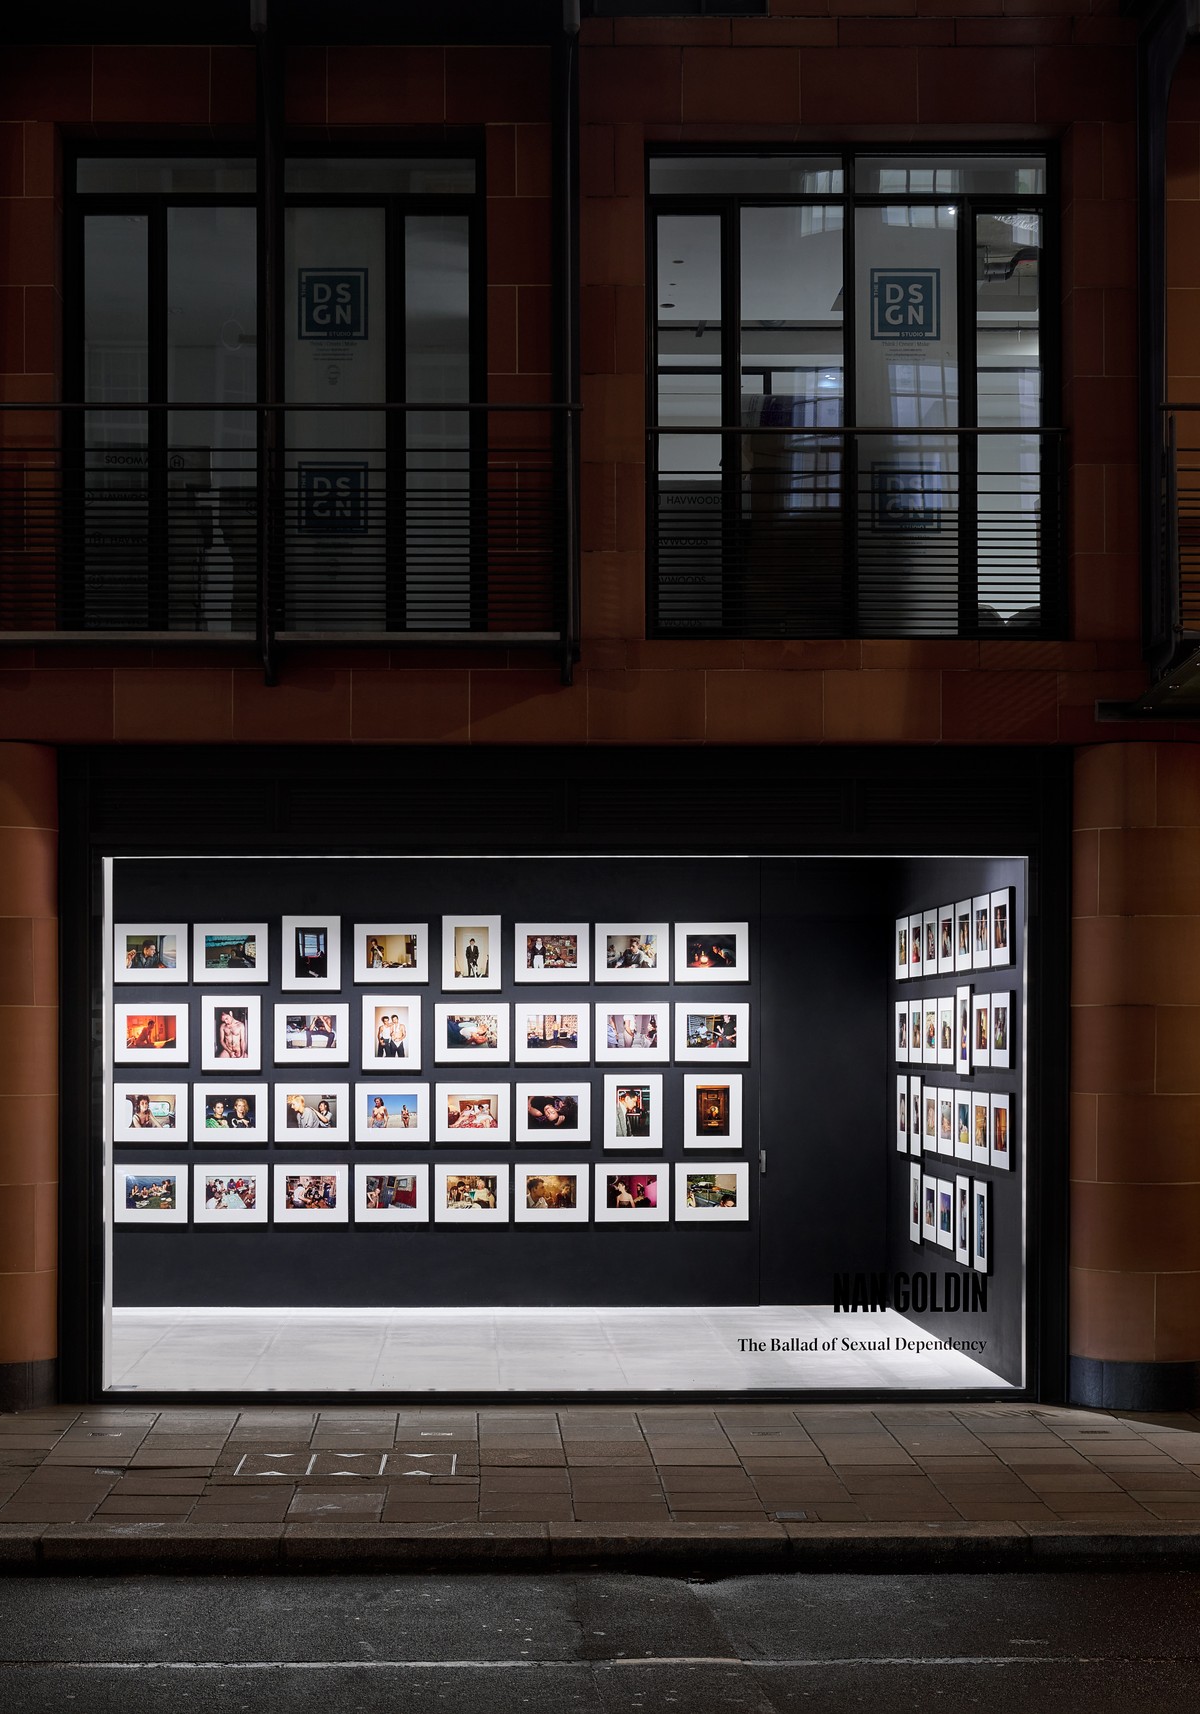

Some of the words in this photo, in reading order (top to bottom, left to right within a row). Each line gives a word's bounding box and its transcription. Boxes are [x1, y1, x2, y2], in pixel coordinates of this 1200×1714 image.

[313, 283, 351, 303] DS
[886, 284, 924, 304] DS
[313, 305, 351, 324] GN
[885, 305, 924, 325] GN
[313, 477, 351, 497] DS
[887, 477, 924, 497] DS
[313, 499, 351, 518] GN
[886, 498, 925, 518] GN
[833, 1272, 887, 1313] NAN
[894, 1272, 988, 1313] GOLDIN
[738, 1338, 767, 1352] The
[771, 1337, 818, 1352] Ballad
[822, 1337, 838, 1352] of
[841, 1337, 890, 1351] Sexual
[895, 1337, 987, 1354] Dependency
